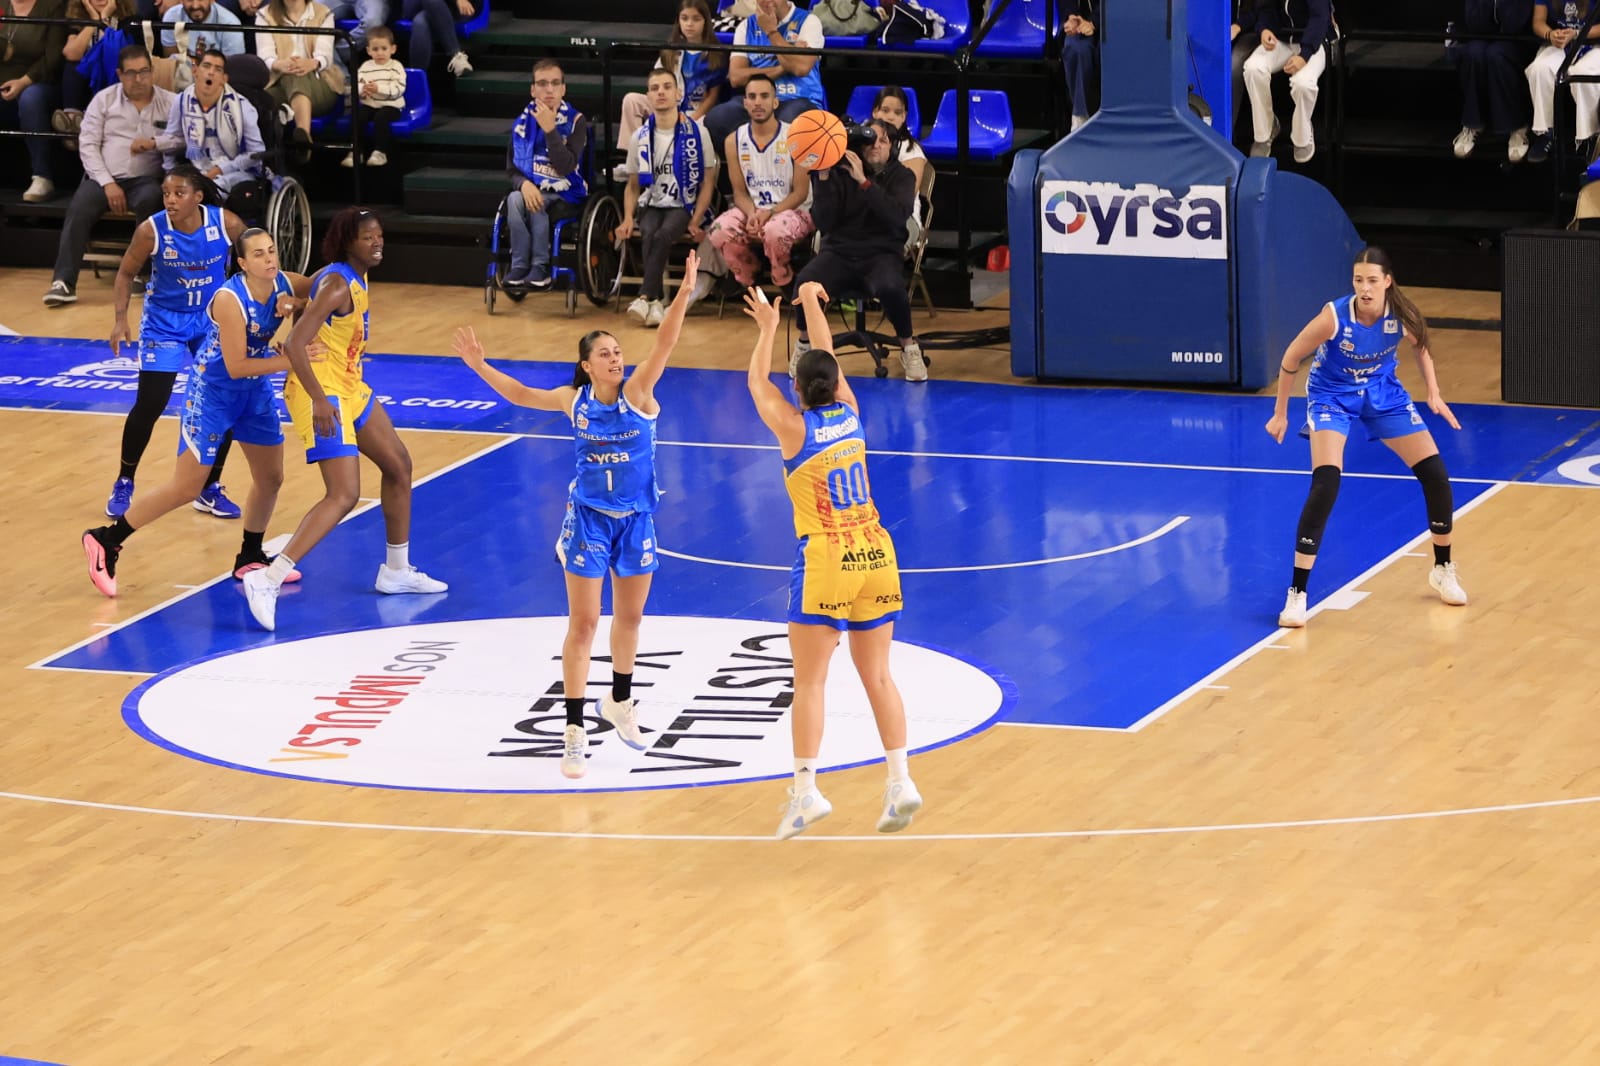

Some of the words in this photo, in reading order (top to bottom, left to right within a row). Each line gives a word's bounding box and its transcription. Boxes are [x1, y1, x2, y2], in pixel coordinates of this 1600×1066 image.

[571, 37, 589, 45] FILA
[590, 38, 596, 46] 2
[163, 260, 197, 268] CASTILLA
[186, 290, 202, 307] 11
[1171, 351, 1223, 364] MONDO
[605, 469, 613, 492] 1
[827, 461, 869, 511] 00
[383, 640, 461, 672] NOS
